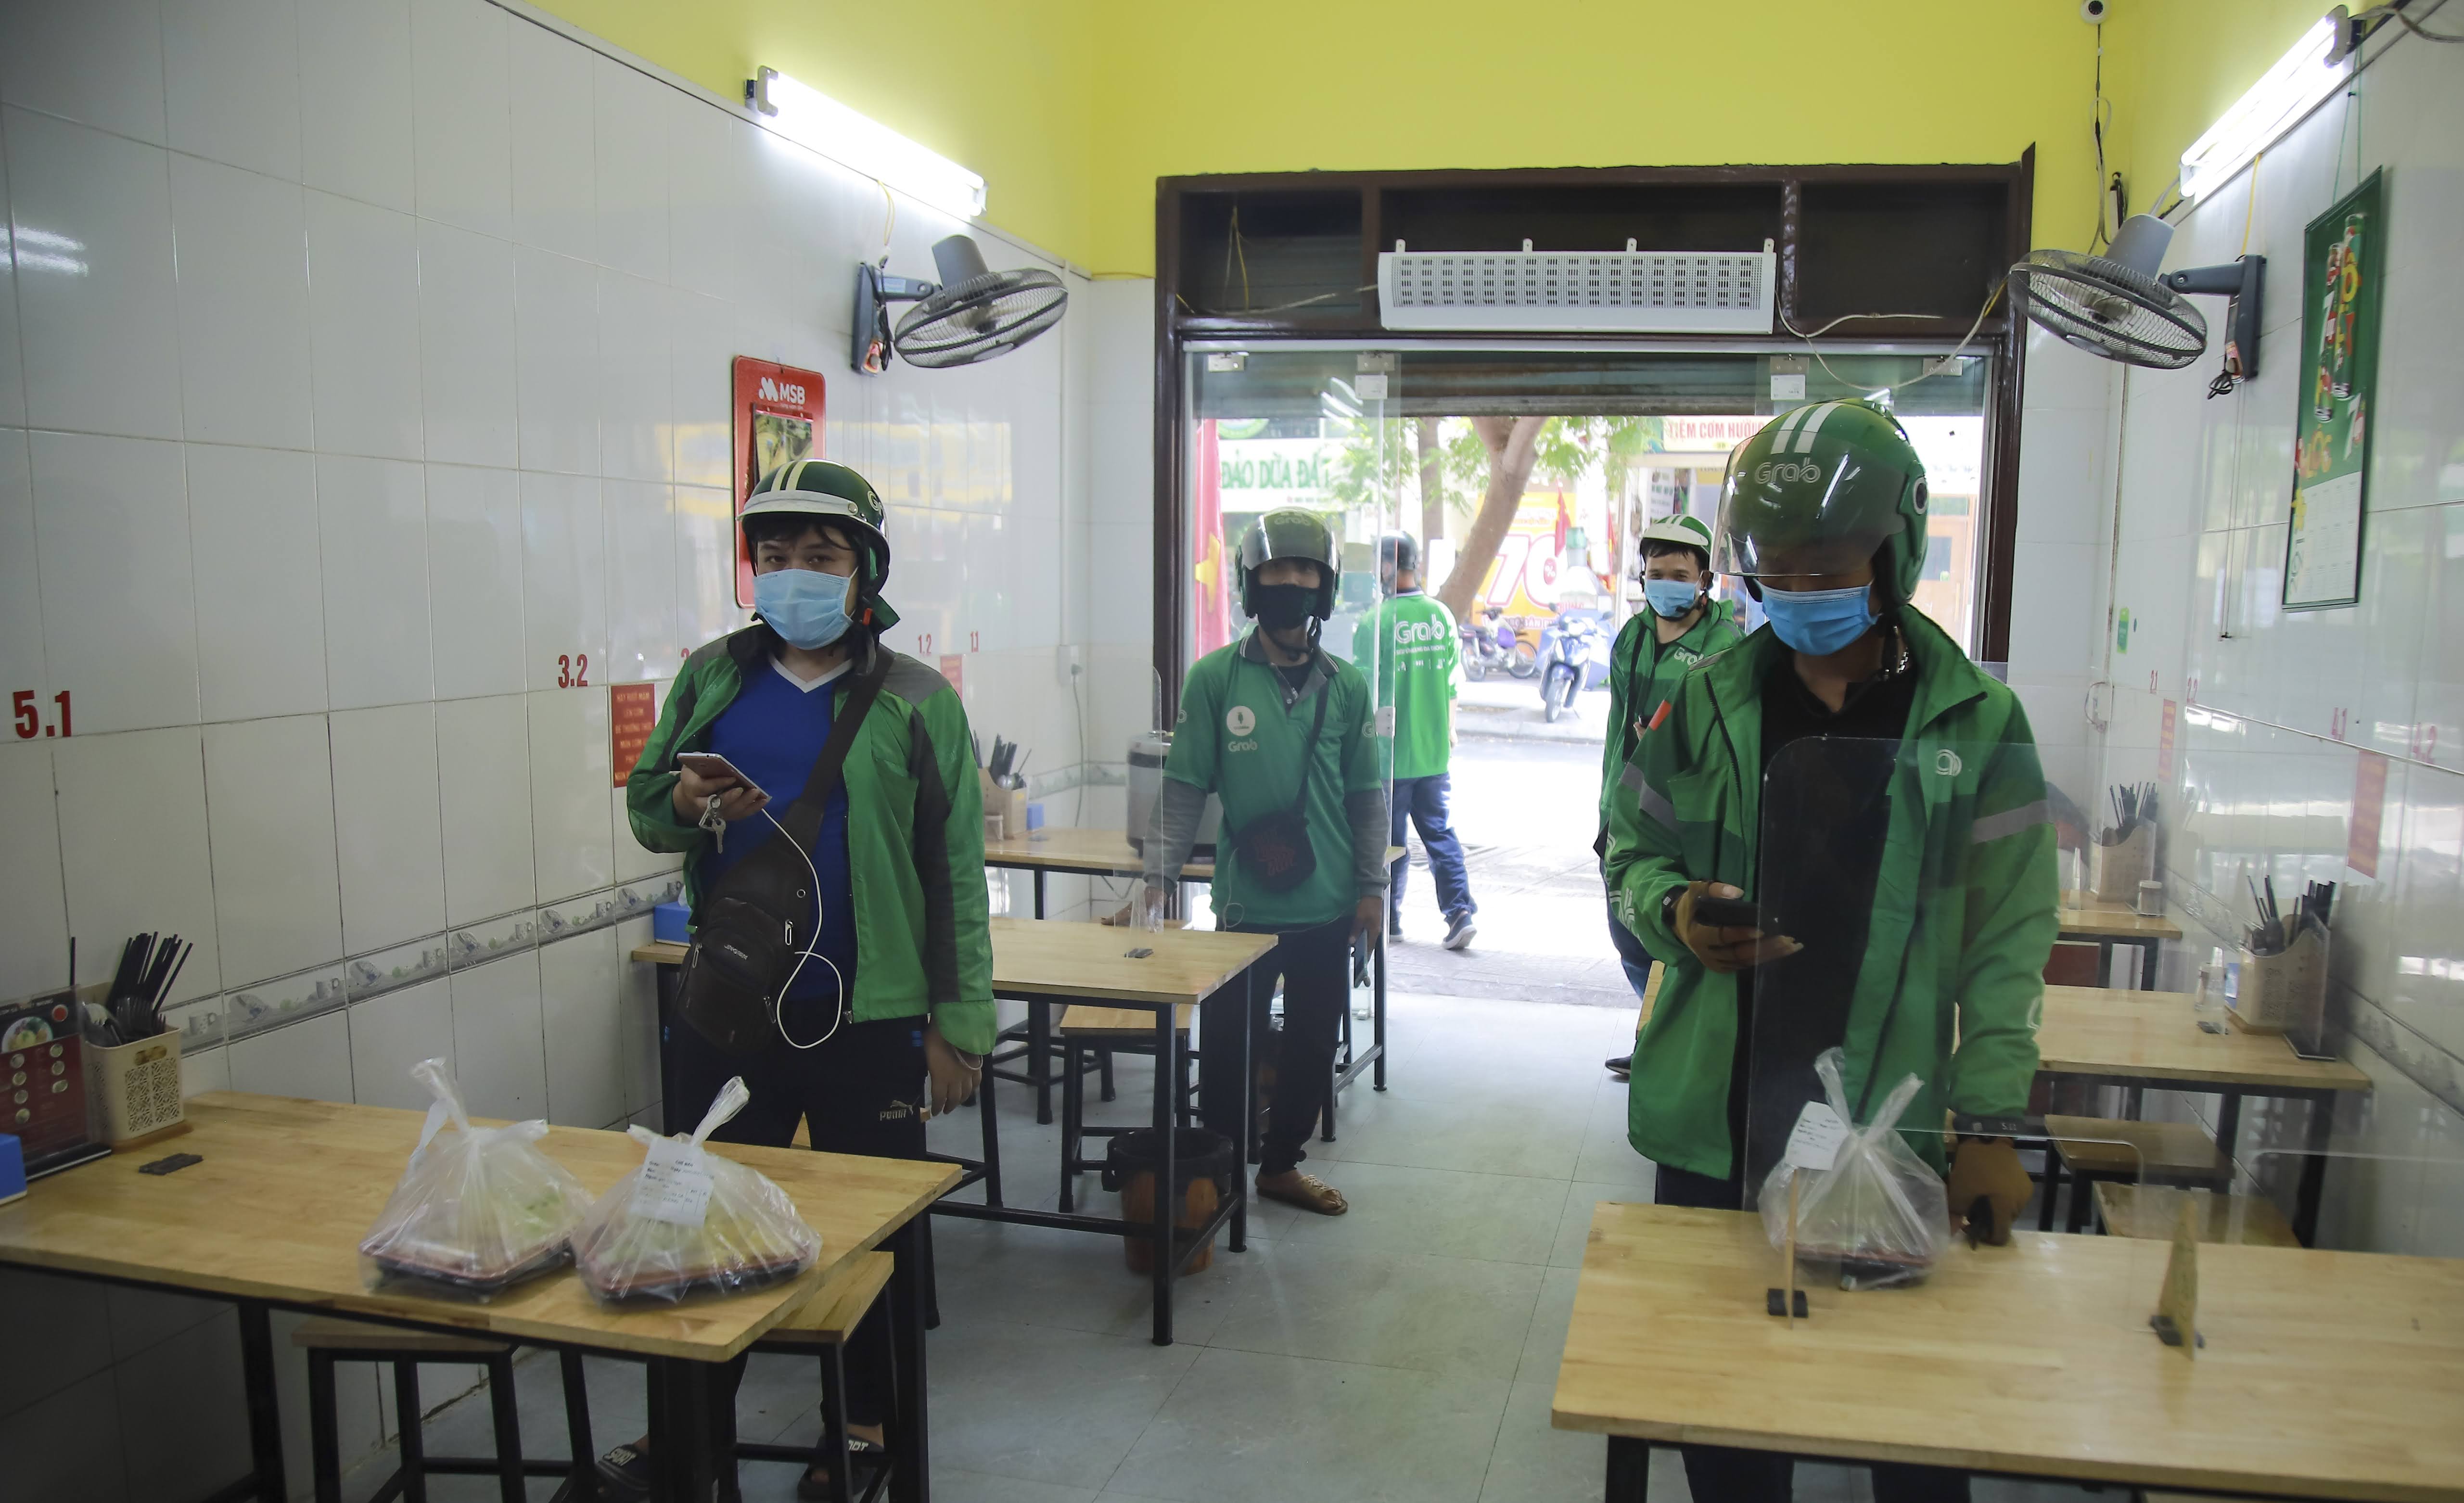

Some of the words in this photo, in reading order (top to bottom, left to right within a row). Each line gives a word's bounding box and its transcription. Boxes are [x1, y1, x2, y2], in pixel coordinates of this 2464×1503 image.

[779, 382, 805, 405] MSB
[1755, 458, 1821, 484] Grab
[1395, 613, 1445, 644] Grab
[918, 634, 932, 655] 1.2
[558, 654, 588, 688] 3.2
[13, 690, 72, 739] 5.1
[1228, 739, 1258, 752] Grab
